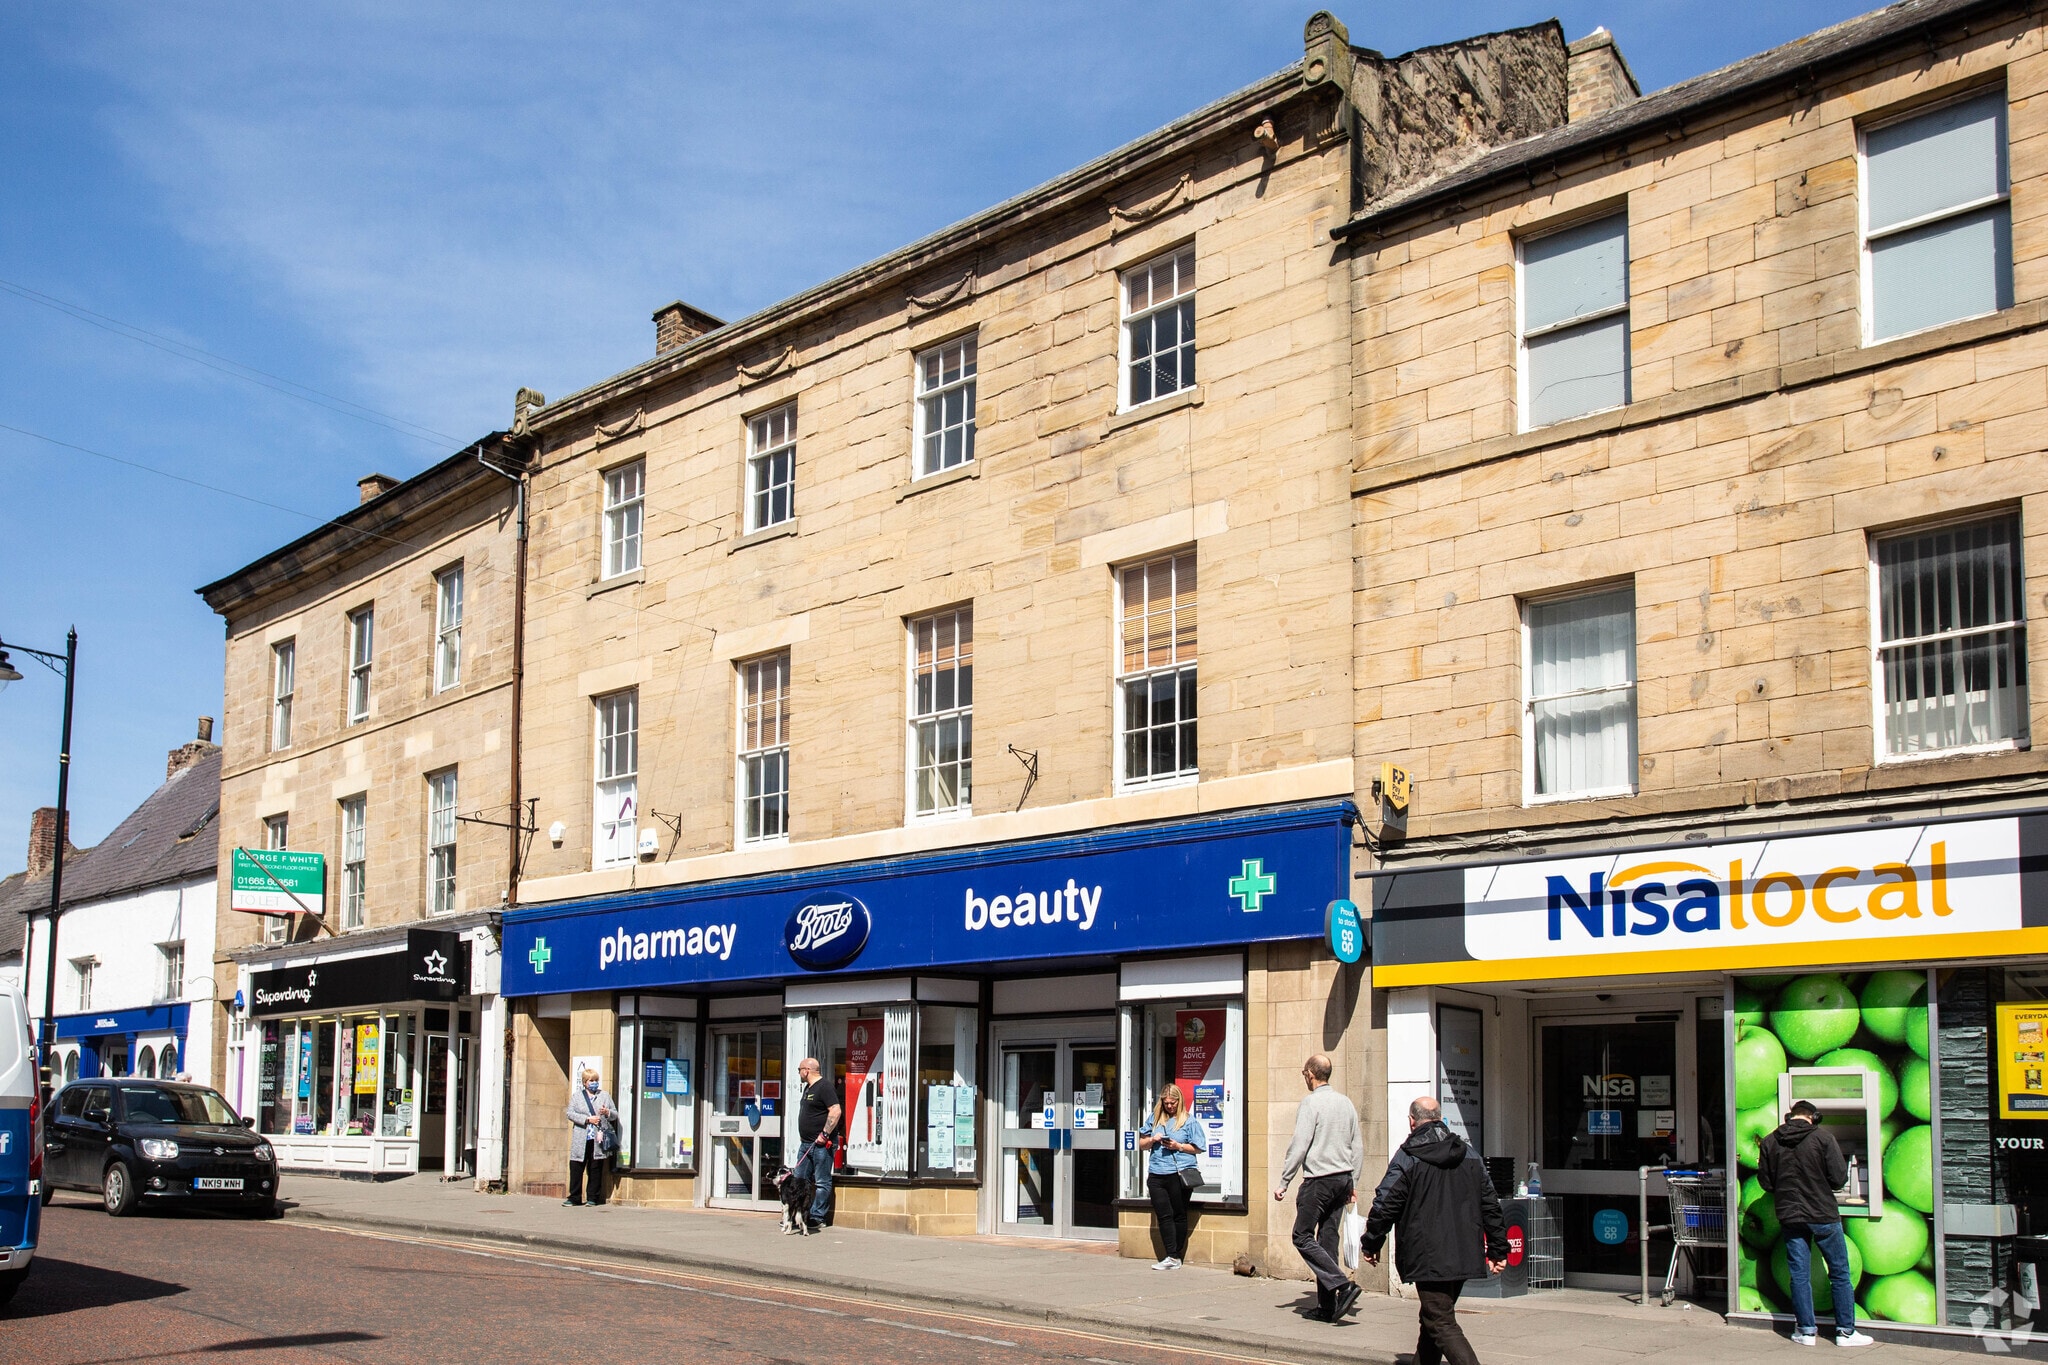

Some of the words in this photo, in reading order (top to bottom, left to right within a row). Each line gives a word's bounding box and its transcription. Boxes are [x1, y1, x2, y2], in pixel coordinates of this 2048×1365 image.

[1392, 784, 1400, 795] Pay
[1392, 792, 1404, 803] Point
[238, 876, 264, 885] 01665
[240, 894, 255, 905] TO
[259, 895, 280, 906] LET
[965, 878, 1102, 931] beauty
[1340, 906, 1354, 917] Proud
[790, 902, 853, 950] Boots
[1344, 919, 1356, 928] stock
[600, 923, 737, 971] pharmacy
[413, 973, 456, 985] Superdrug
[256, 986, 311, 1006] Superdrug
[261, 1044, 277, 1052] BEAUTY
[1582, 1074, 1635, 1096] Nisa
[1996, 1138, 2044, 1149] YOUR
[202, 1179, 222, 1187] NK19
